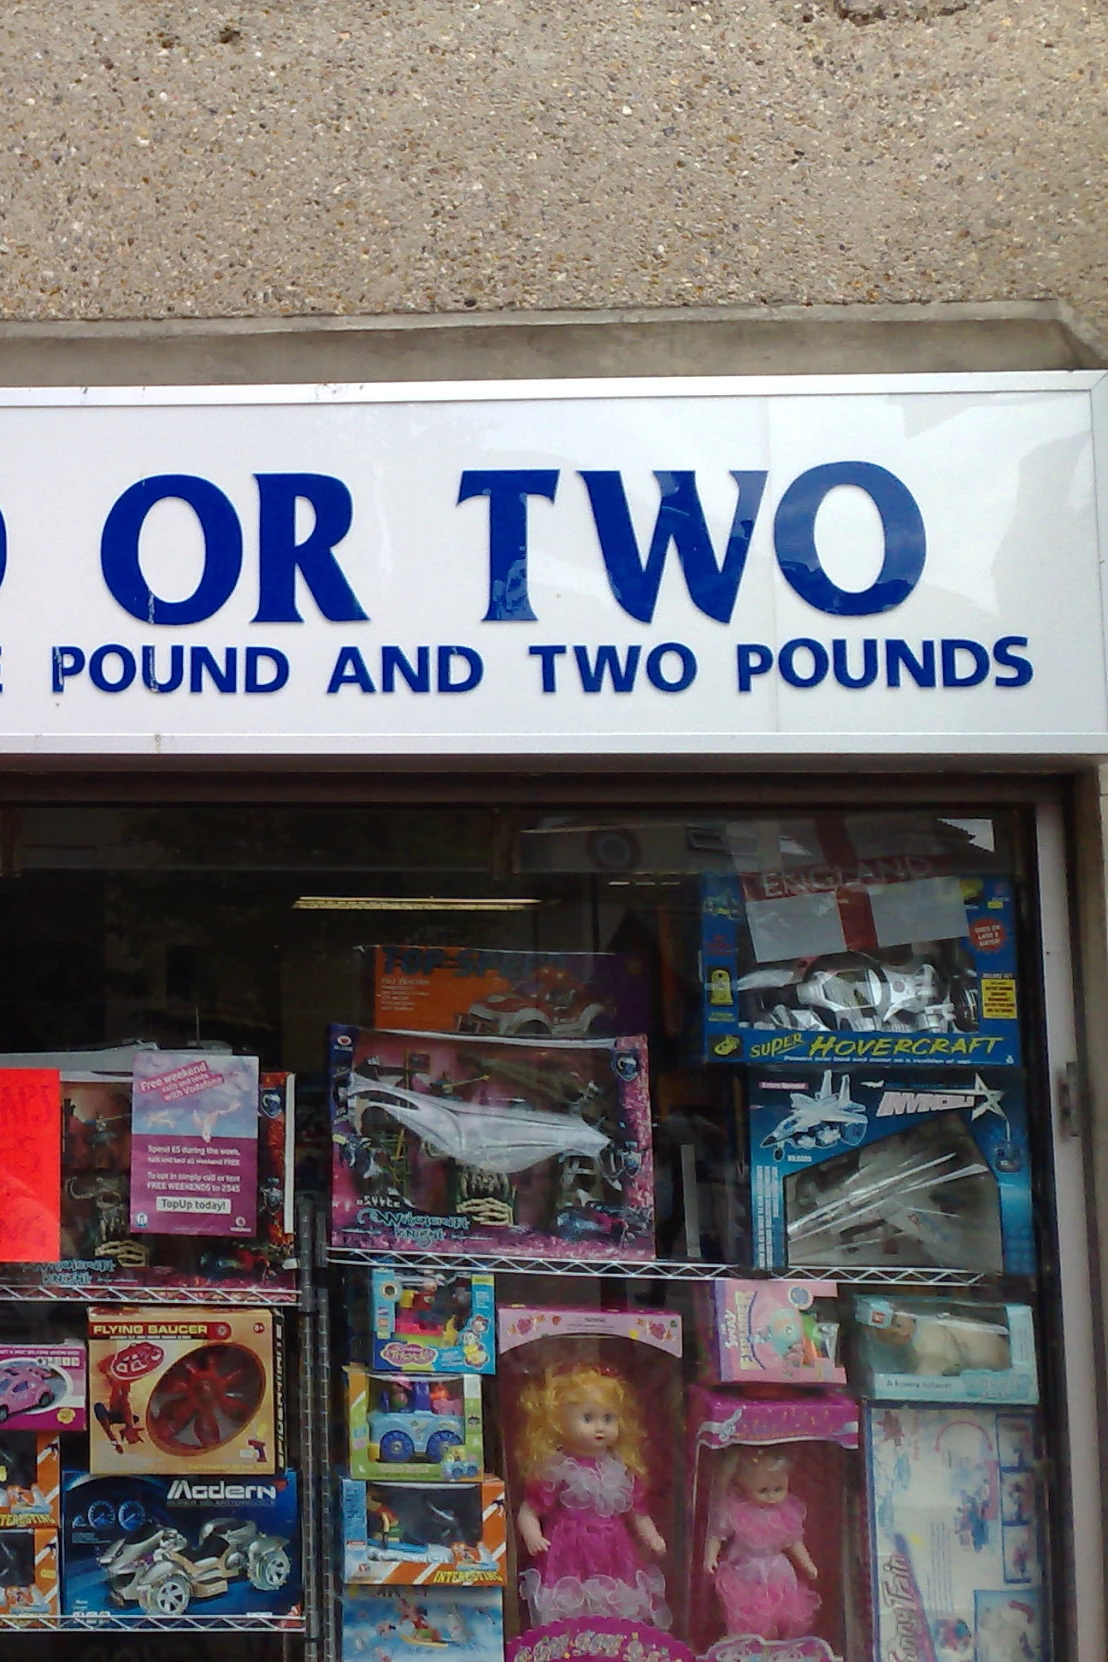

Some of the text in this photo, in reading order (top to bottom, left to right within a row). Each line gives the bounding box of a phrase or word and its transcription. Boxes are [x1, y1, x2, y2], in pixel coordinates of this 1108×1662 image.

[100, 472, 370, 626] OR
[456, 460, 928, 625] TWO
[50, 643, 290, 694] POUND
[326, 645, 485, 694] AND
[528, 642, 699, 694] TWO
[736, 635, 1035, 692] POUNDS
[749, 1032, 803, 1059] SUPER
[809, 1036, 1003, 1058] HOVERCRAFT
[140, 1062, 208, 1092] Free weekend
[182, 1076, 223, 1096] Vodafone
[147, 1145, 171, 1155] Spend
[181, 1146, 206, 1156] during
[207, 1147, 219, 1155] the
[147, 1182, 168, 1190] FREE
[212, 1184, 221, 1192] to
[161, 1198, 226, 1212] TopUp today!
[93, 1324, 208, 1335] FLYING SAUCER
[166, 1479, 277, 1500] Modern
